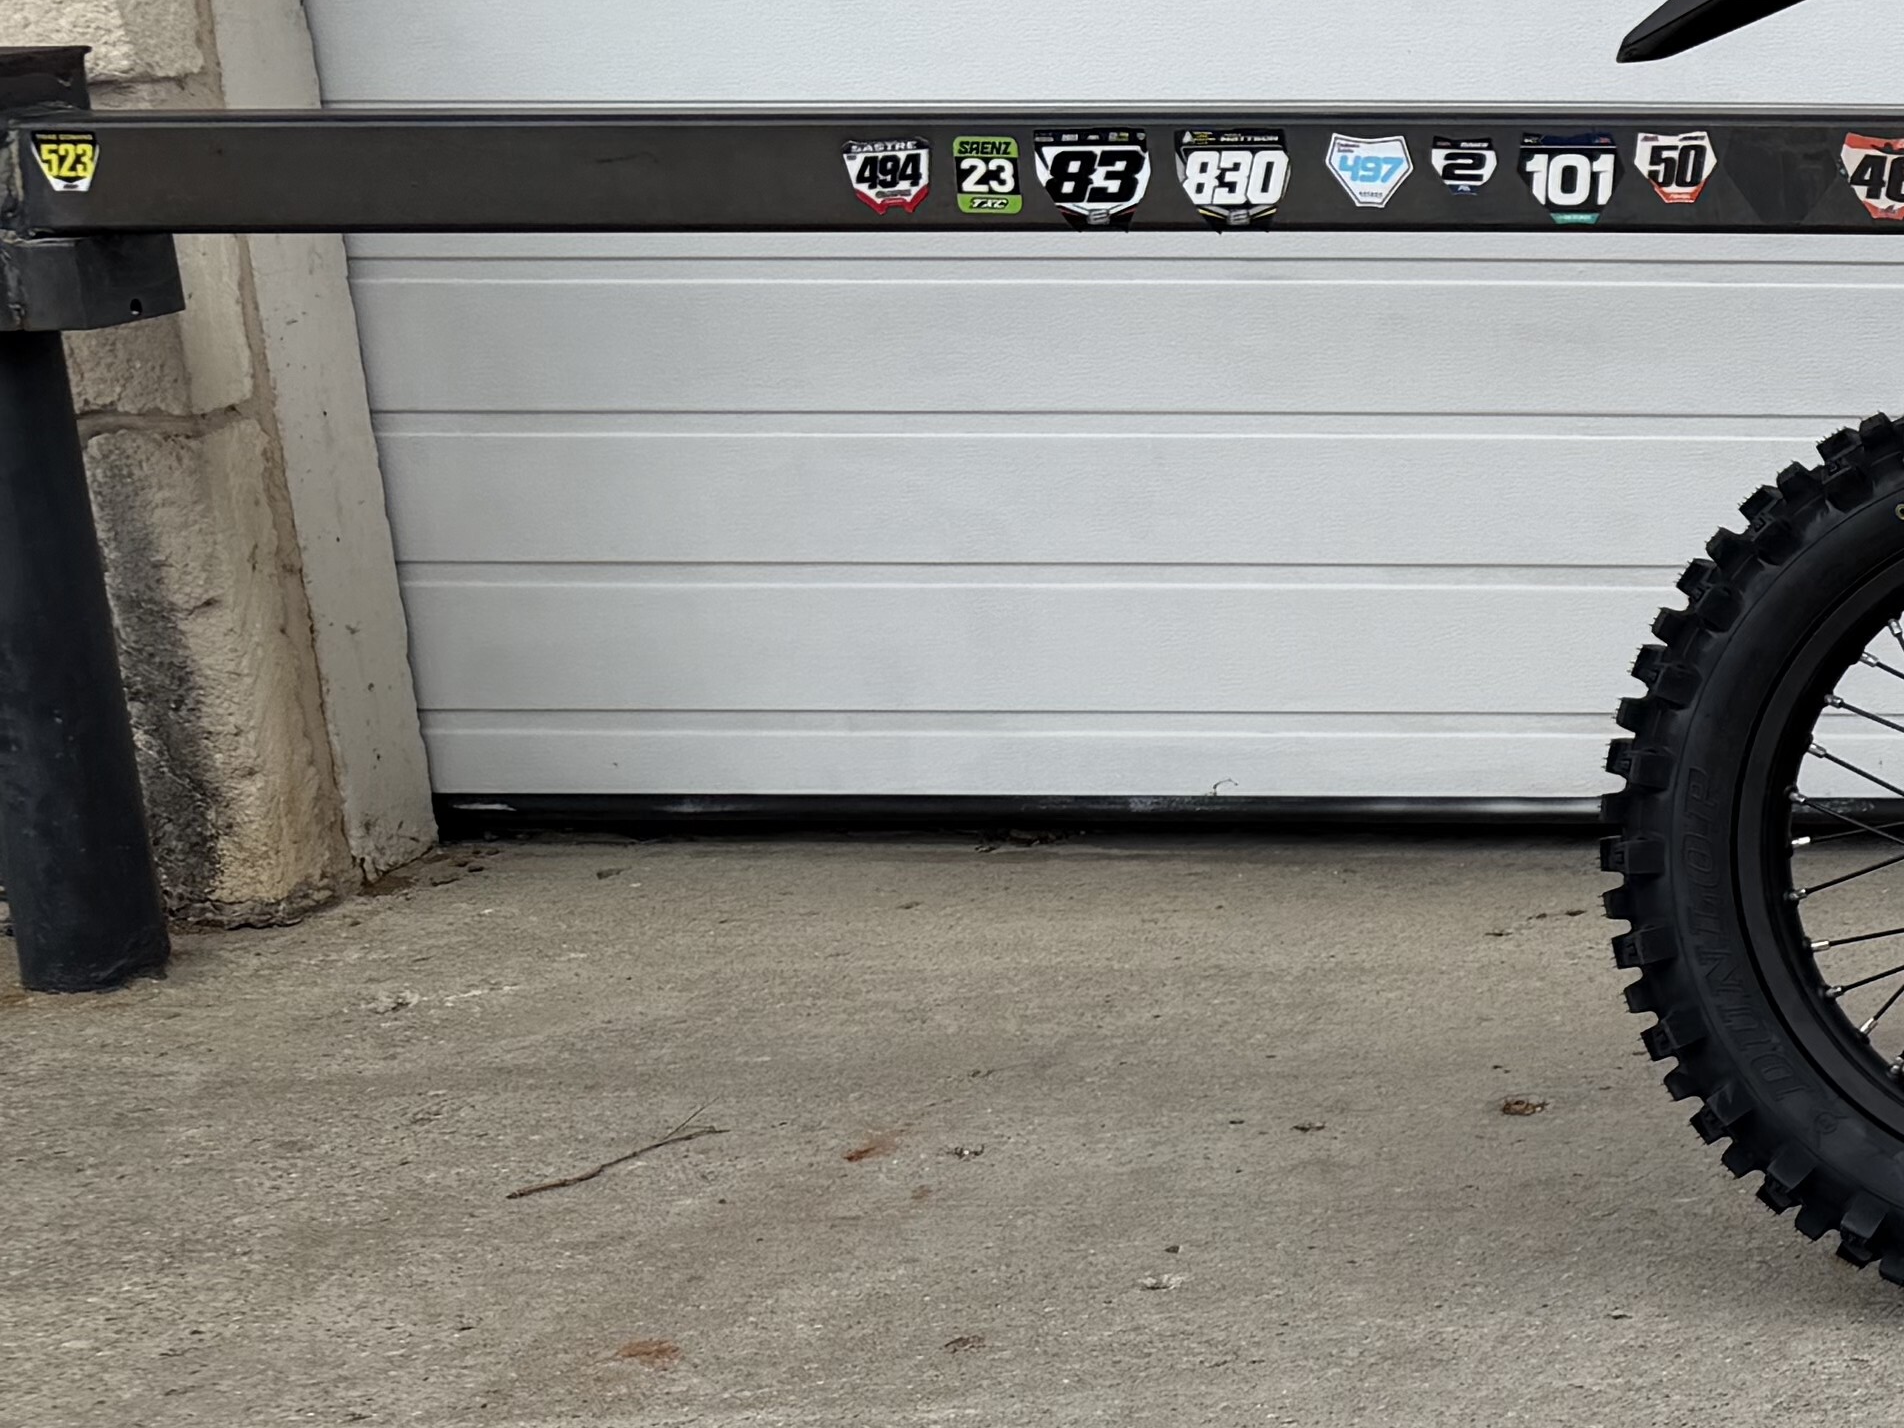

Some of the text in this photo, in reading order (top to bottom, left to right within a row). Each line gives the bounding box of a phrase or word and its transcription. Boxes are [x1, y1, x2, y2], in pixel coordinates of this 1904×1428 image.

[41, 144, 93, 176] 523
[958, 141, 1011, 155] SAENZ
[856, 153, 922, 189] 494
[960, 158, 1015, 193] 23
[1046, 150, 1146, 203] 83
[1182, 150, 1289, 204] 830
[1339, 155, 1404, 183] 497
[1442, 152, 1486, 182] 2
[1525, 153, 1616, 206] 101
[1648, 144, 1707, 188] 50
